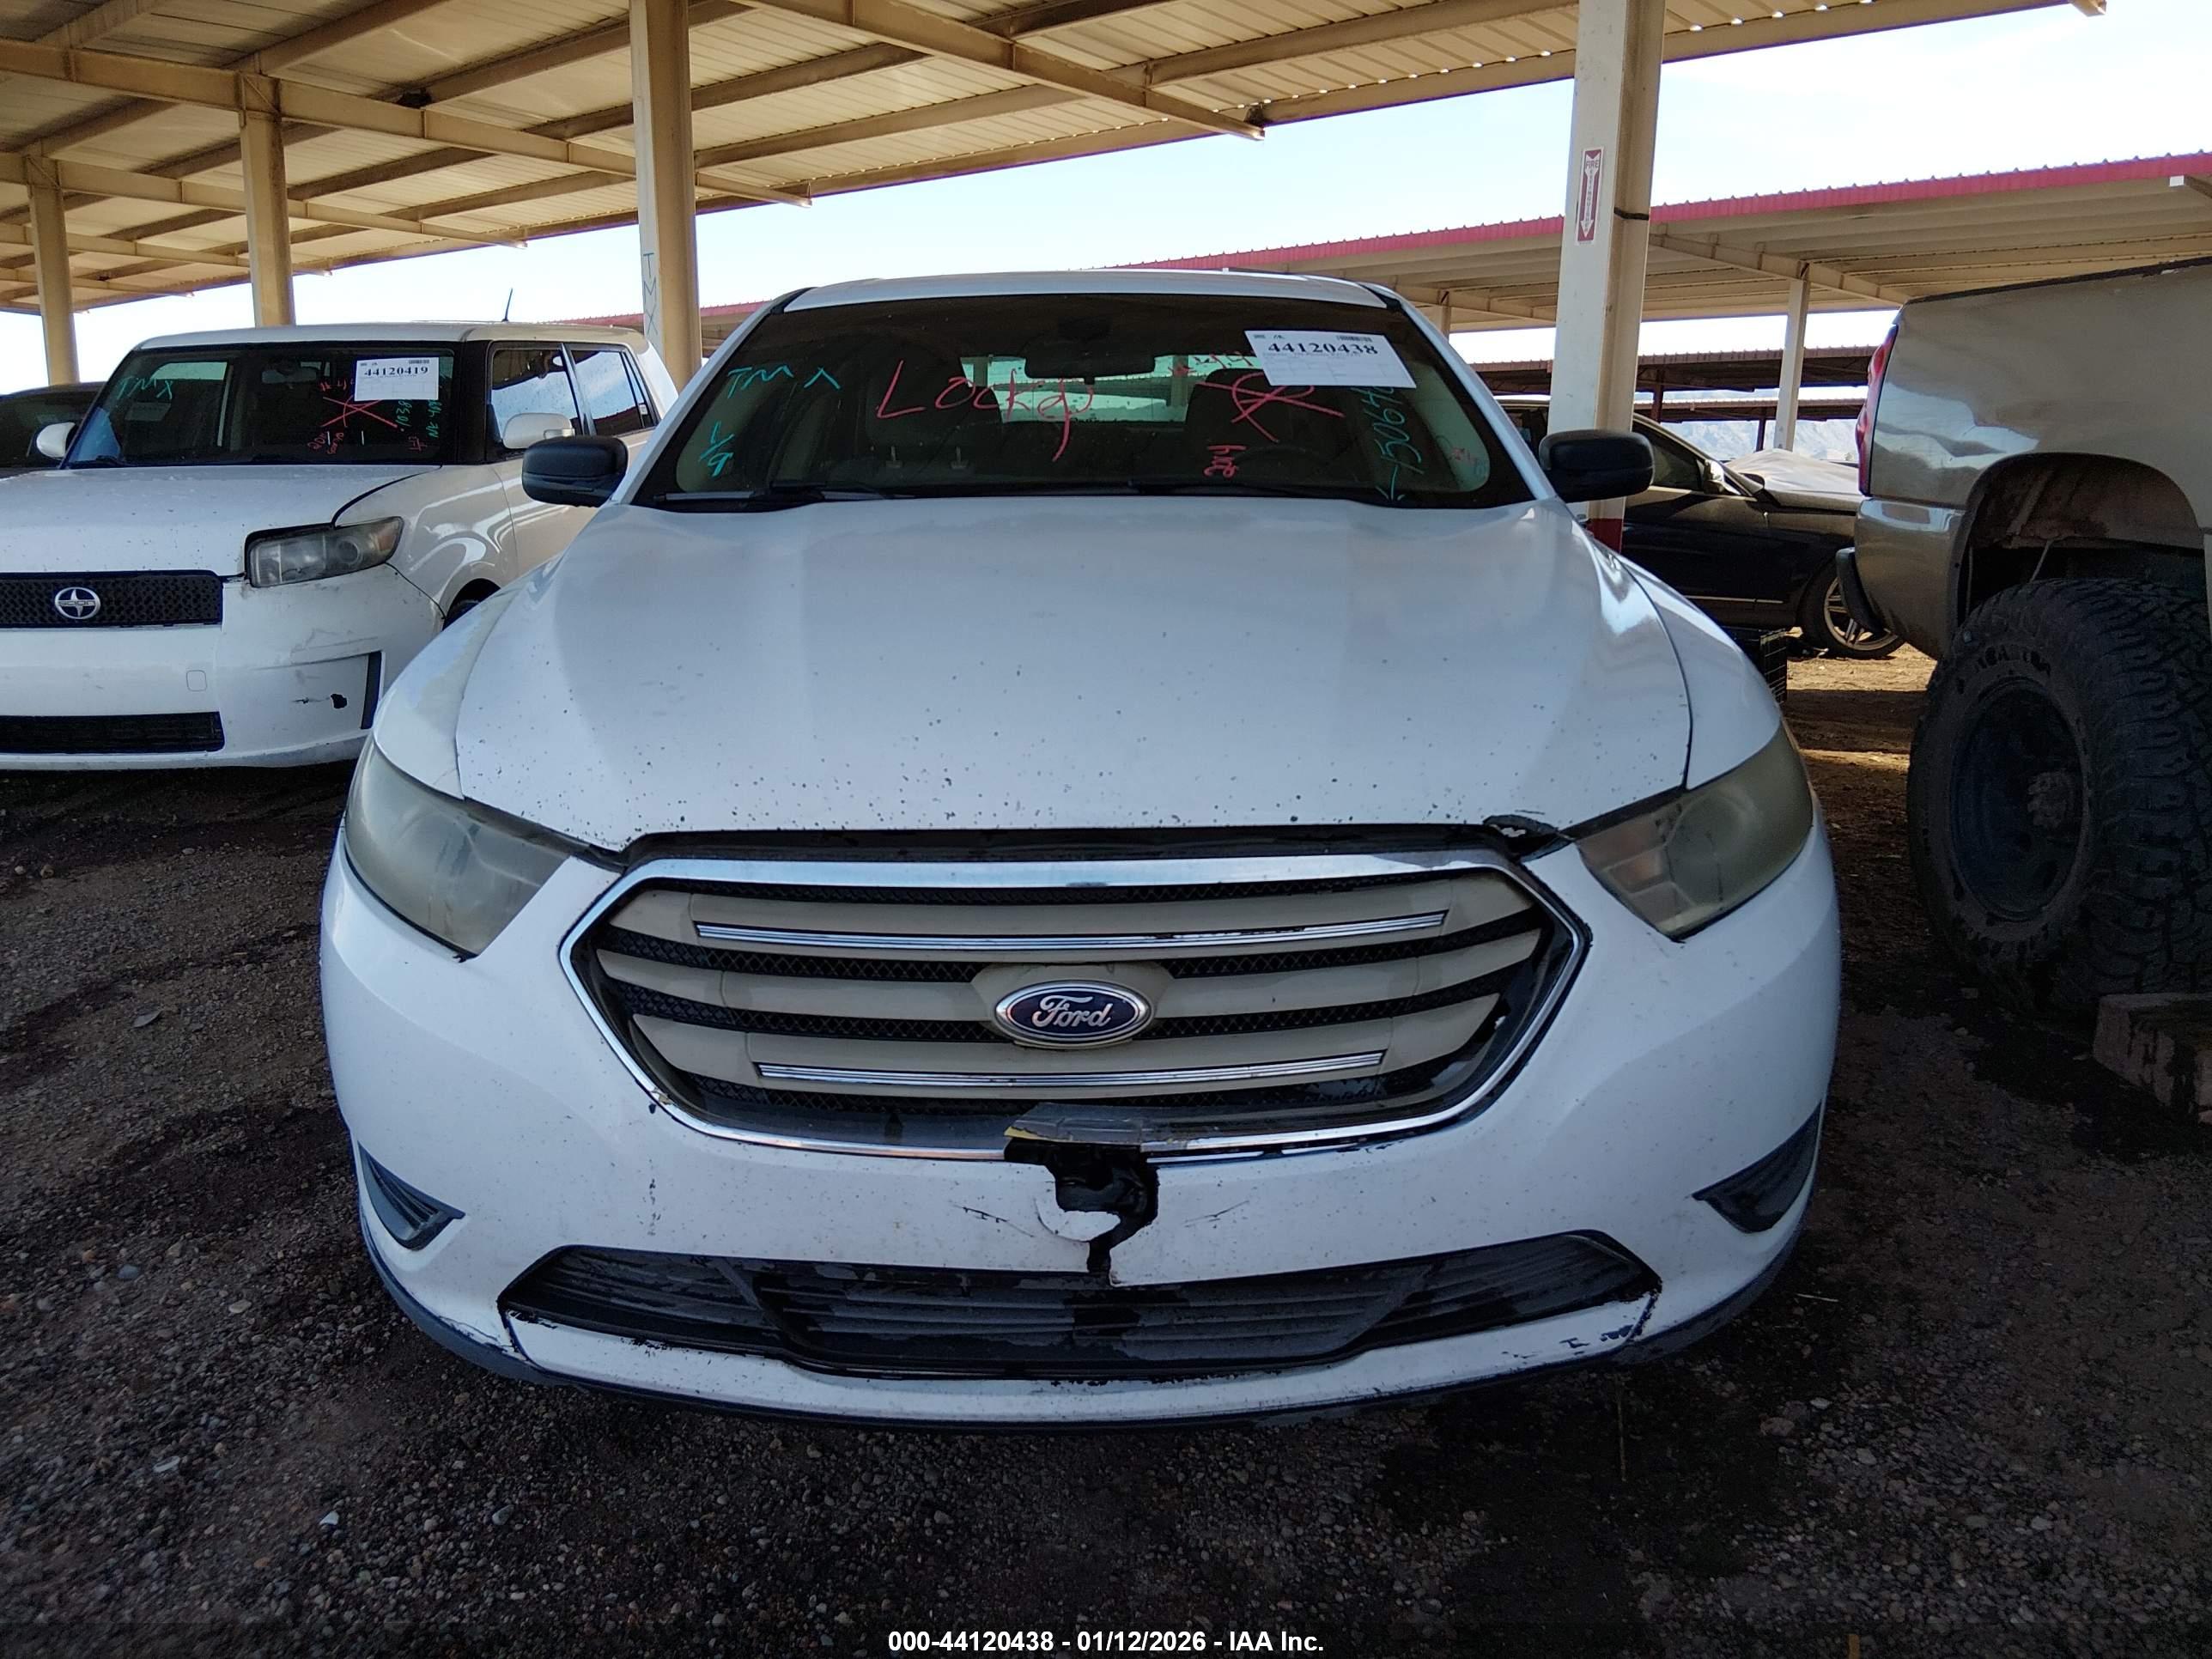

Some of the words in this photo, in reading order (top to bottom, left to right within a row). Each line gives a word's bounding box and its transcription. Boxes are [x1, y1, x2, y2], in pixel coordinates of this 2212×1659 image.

[642, 252, 659, 336] TMX
[1268, 343, 1378, 355] 44120438
[364, 367, 428, 376] 44120419
[1031, 994, 1114, 1028] Ford
